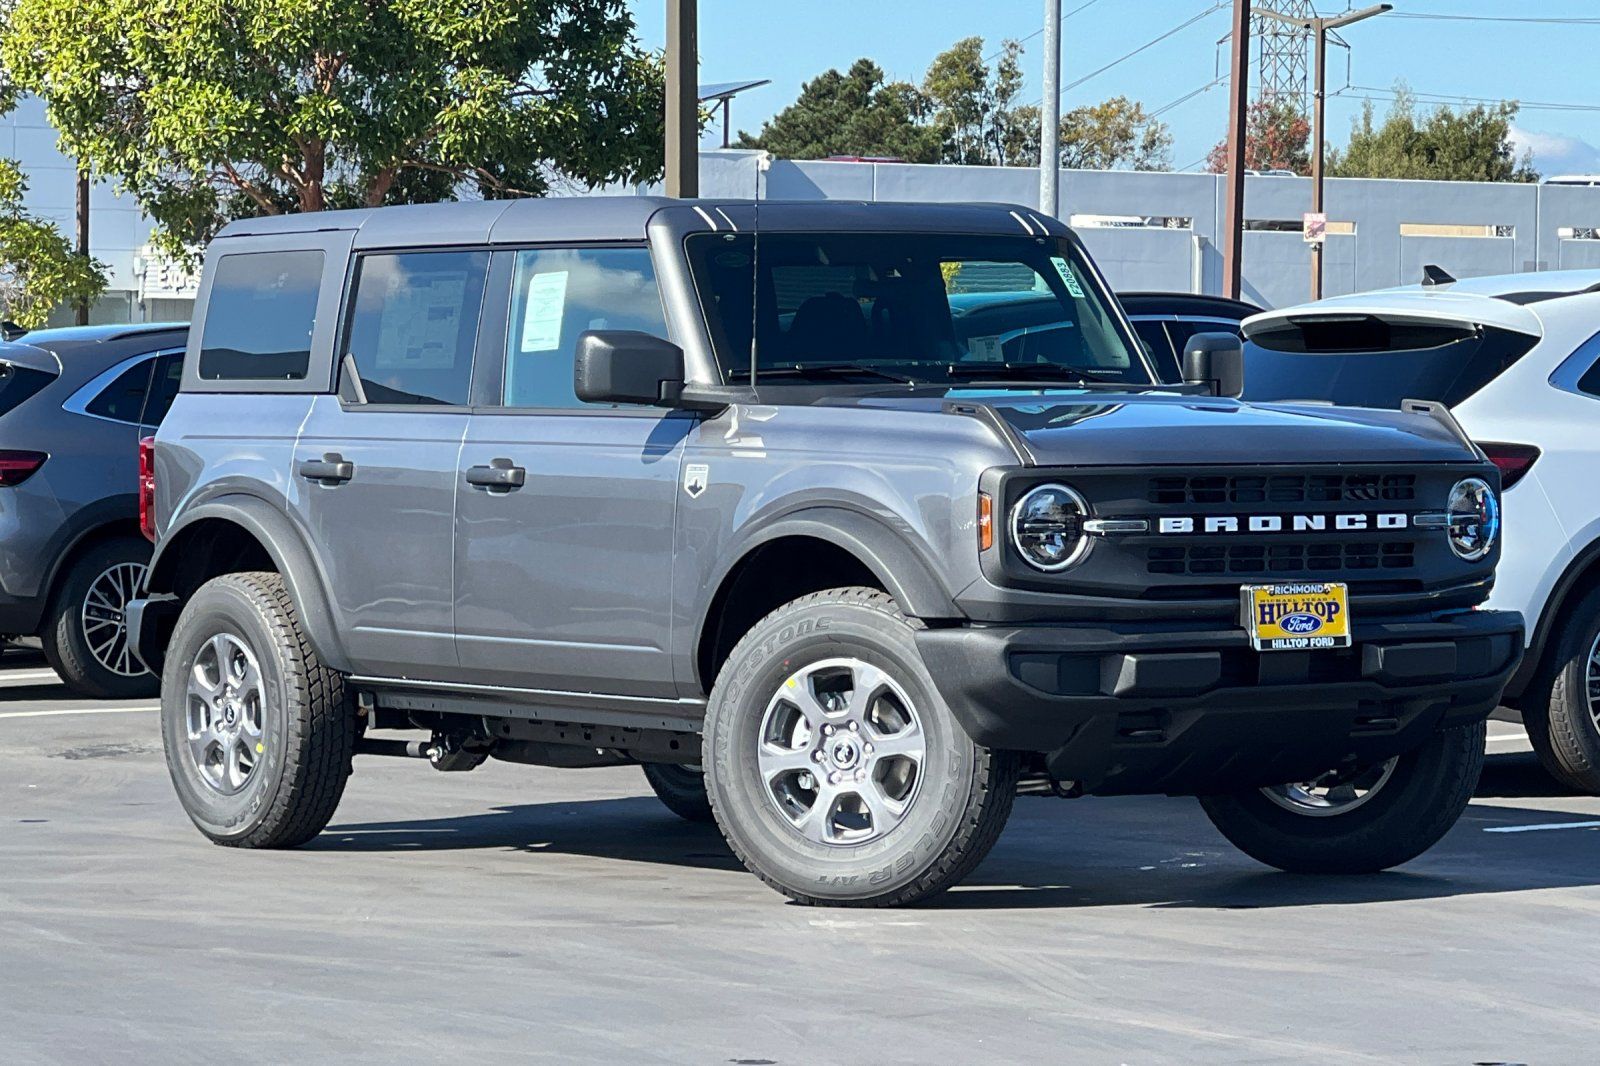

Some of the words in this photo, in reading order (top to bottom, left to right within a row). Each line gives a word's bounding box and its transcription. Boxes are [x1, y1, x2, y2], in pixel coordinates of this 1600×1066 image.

[1159, 513, 1408, 534] BRONCO
[1274, 584, 1324, 595] RICHMOND
[1258, 601, 1340, 625] HILLTOP
[1287, 615, 1315, 631] Ford
[1271, 638, 1309, 649] HILLTOP
[1310, 637, 1335, 647] FORD
